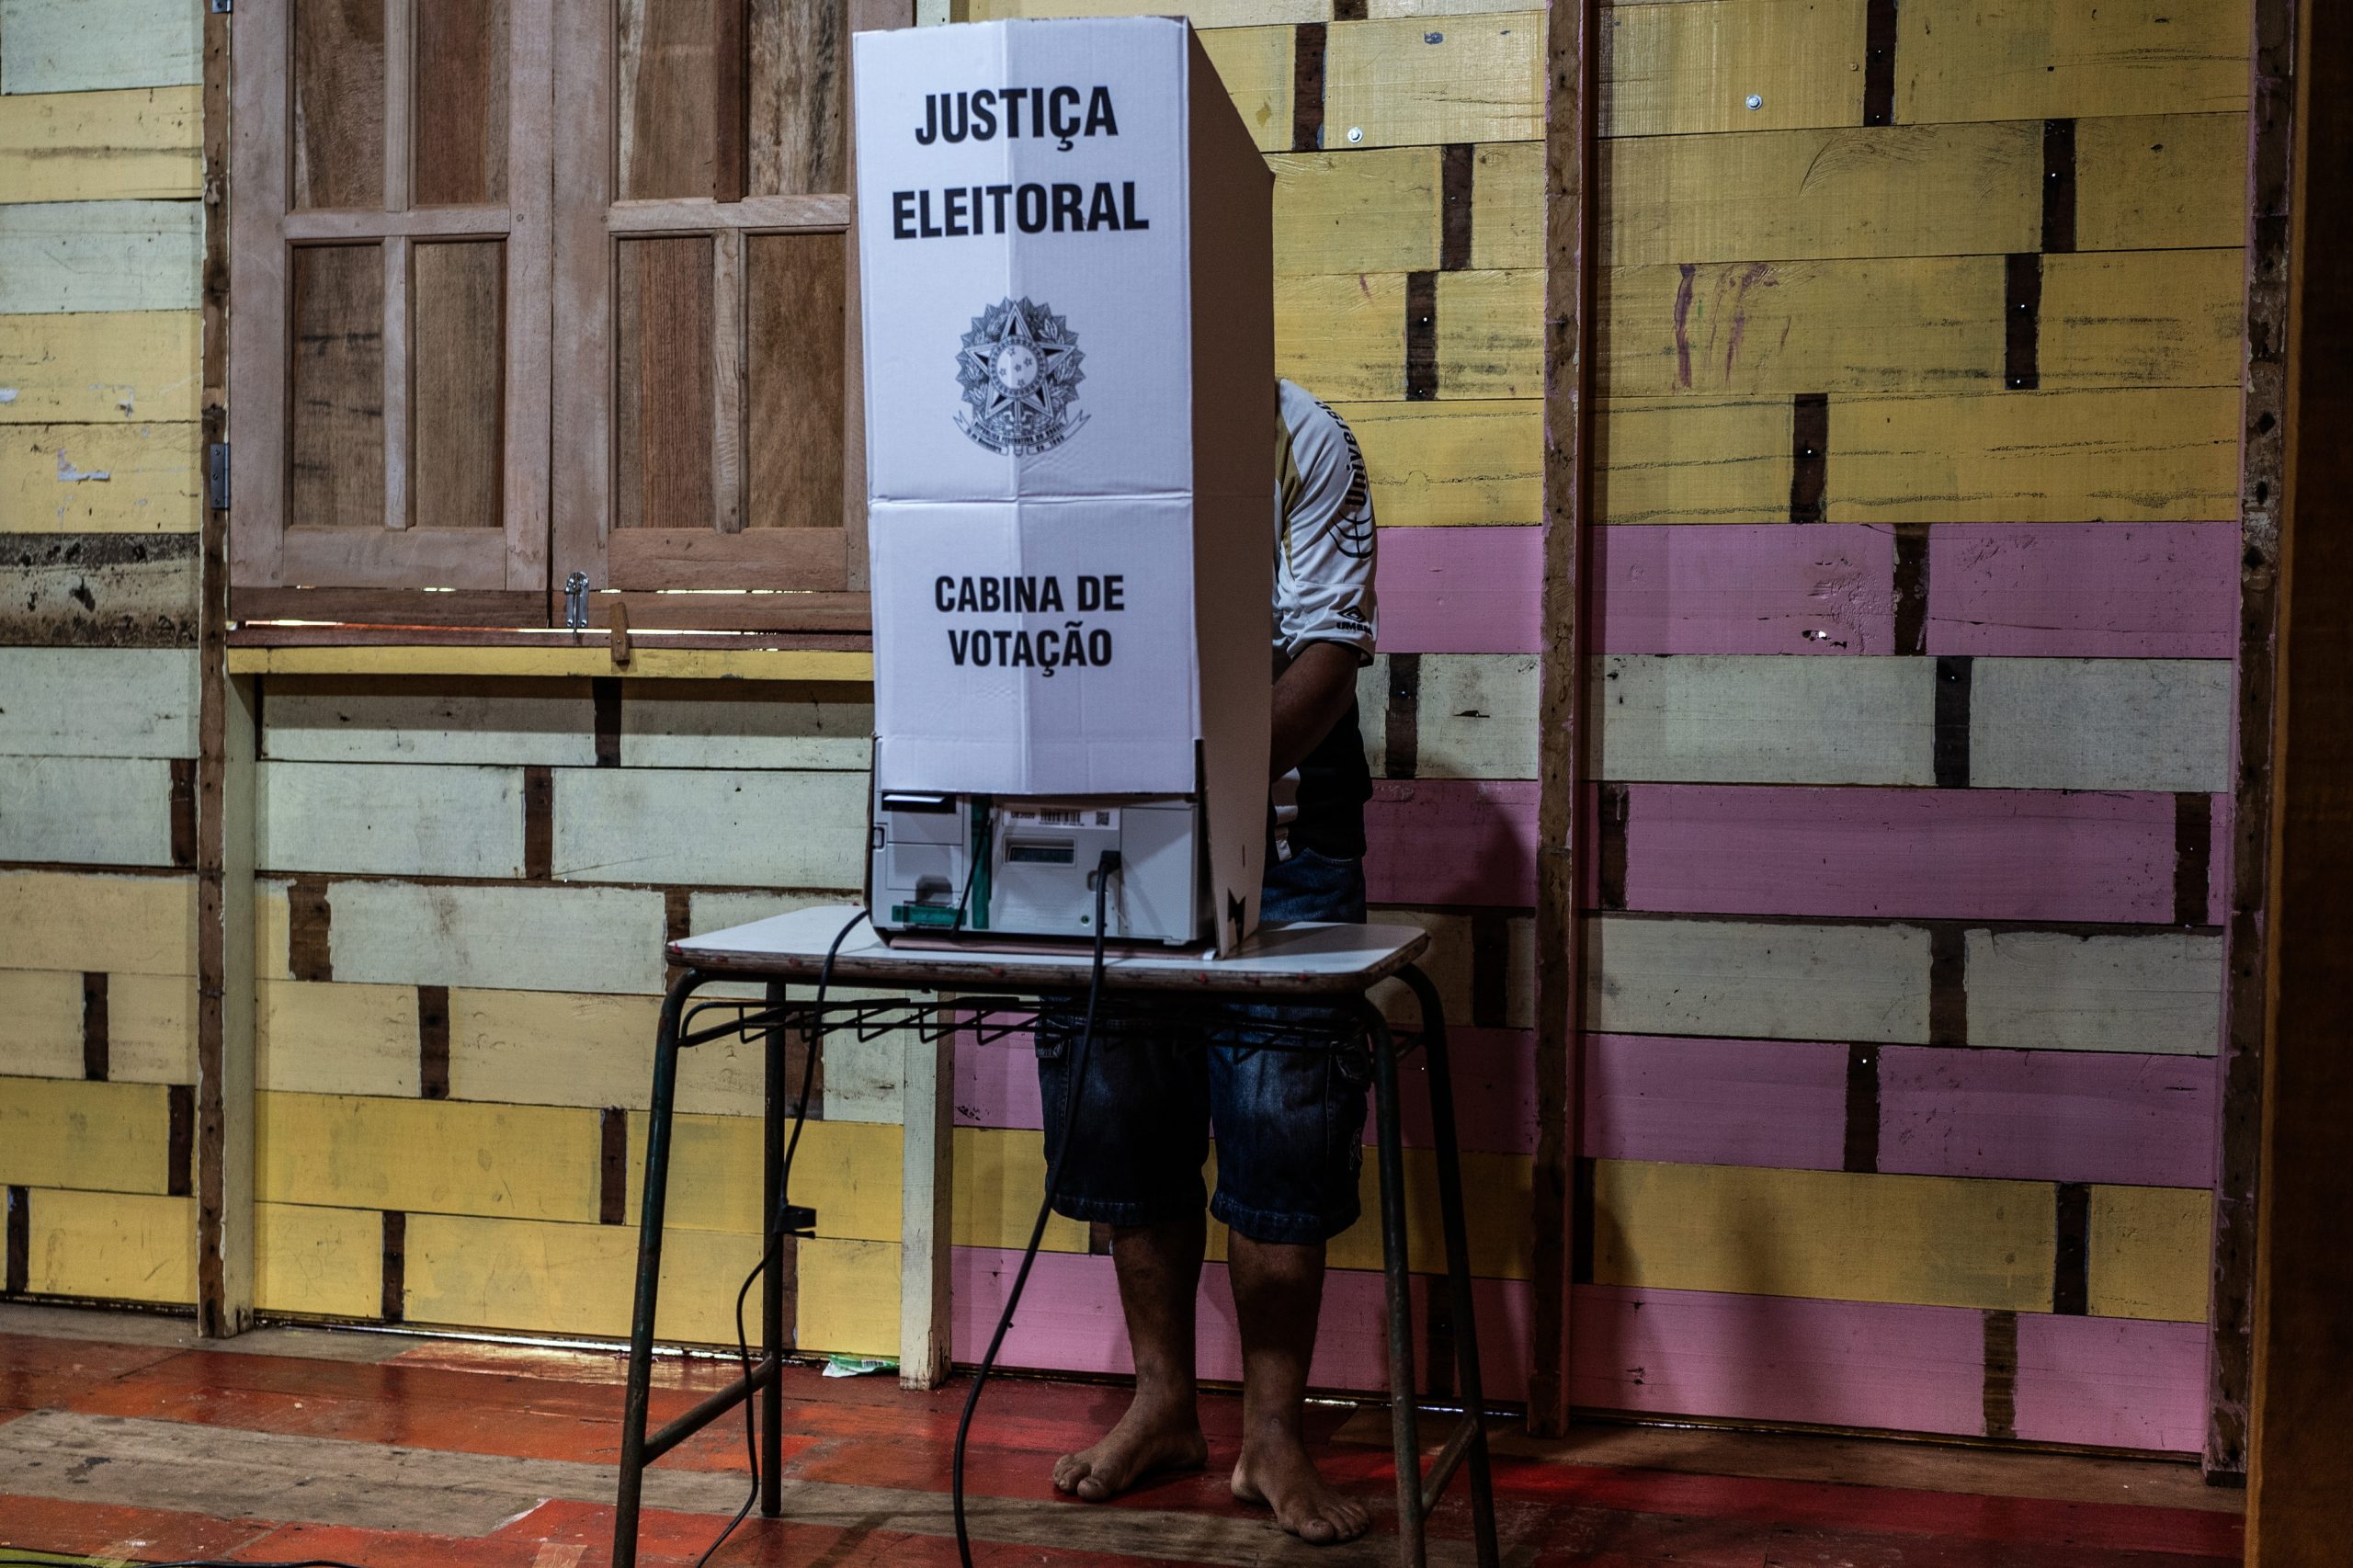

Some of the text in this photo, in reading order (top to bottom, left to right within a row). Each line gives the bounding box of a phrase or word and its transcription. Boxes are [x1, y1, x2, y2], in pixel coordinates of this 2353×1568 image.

[915, 85, 1119, 152] JUSTIÇA
[892, 181, 1150, 239] ELEITORAL
[935, 574, 1125, 613] CABINA DE
[948, 620, 1112, 678] VOTAÇÃO
